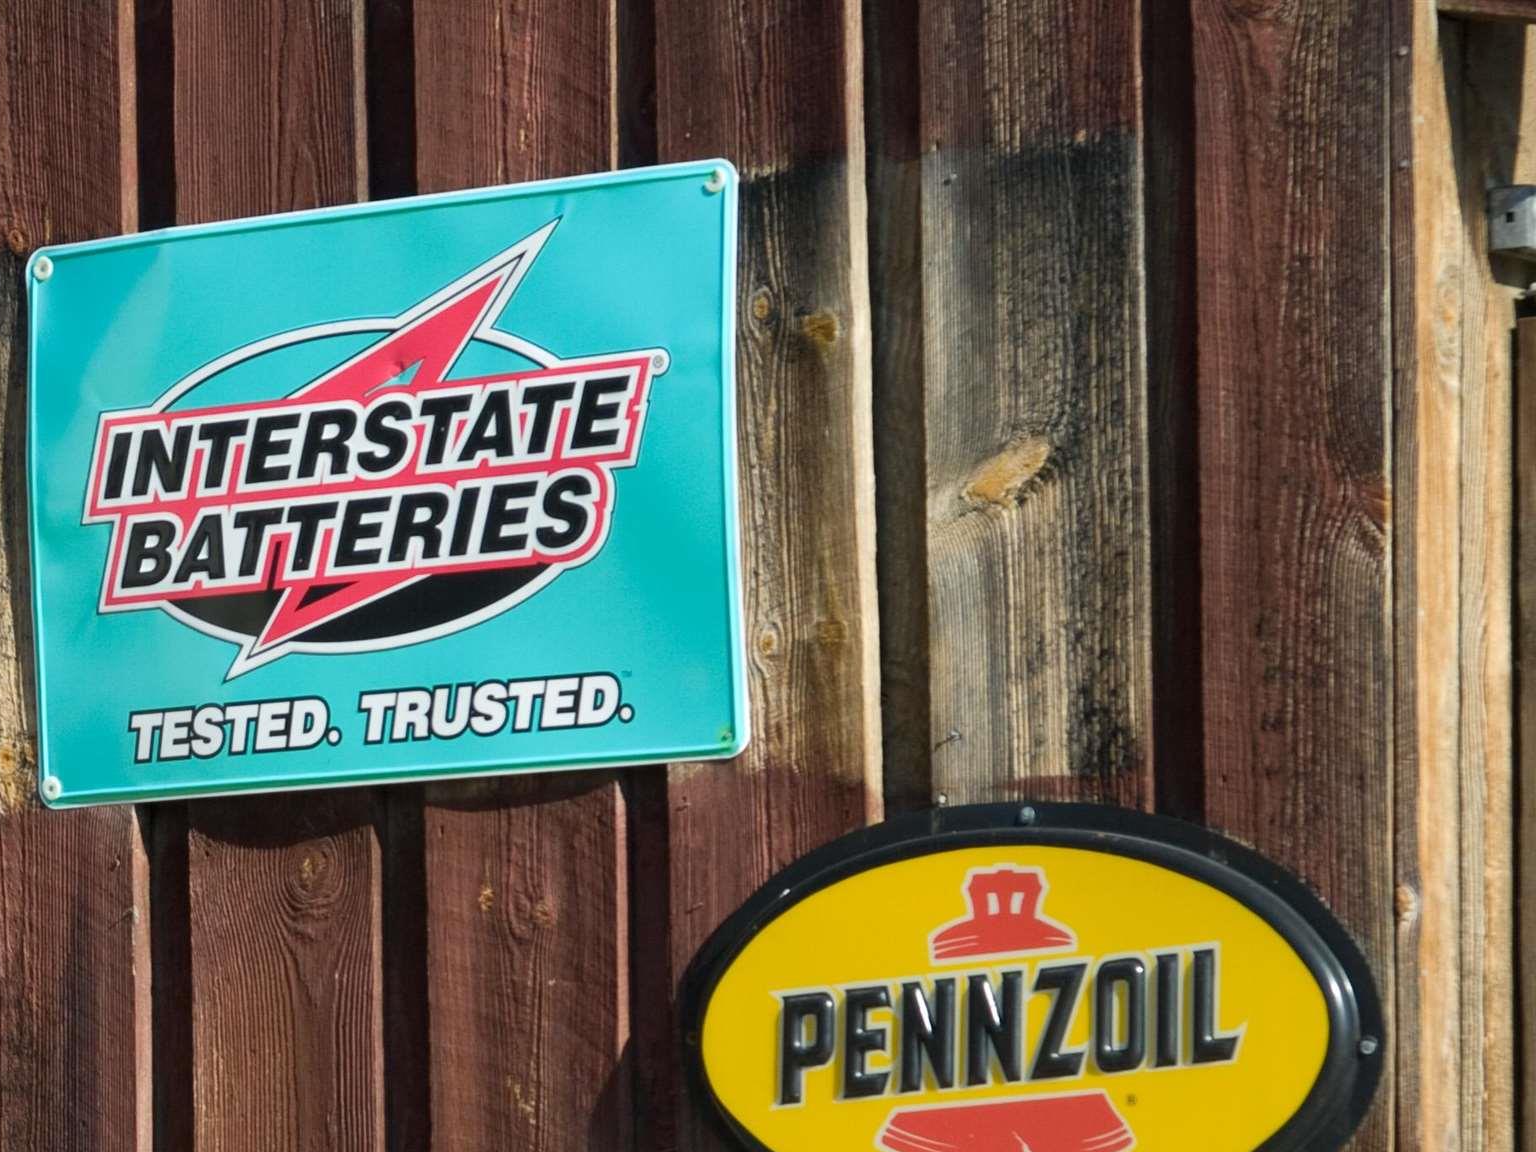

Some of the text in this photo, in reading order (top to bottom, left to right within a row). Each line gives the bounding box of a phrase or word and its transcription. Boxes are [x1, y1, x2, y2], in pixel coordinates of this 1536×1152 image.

[104, 375, 630, 500] INTERSTATE
[121, 474, 593, 589] BATTERIES
[129, 672, 636, 764] TESTED. TRUSTED.
[772, 943, 1245, 1105] PENNZOIL
